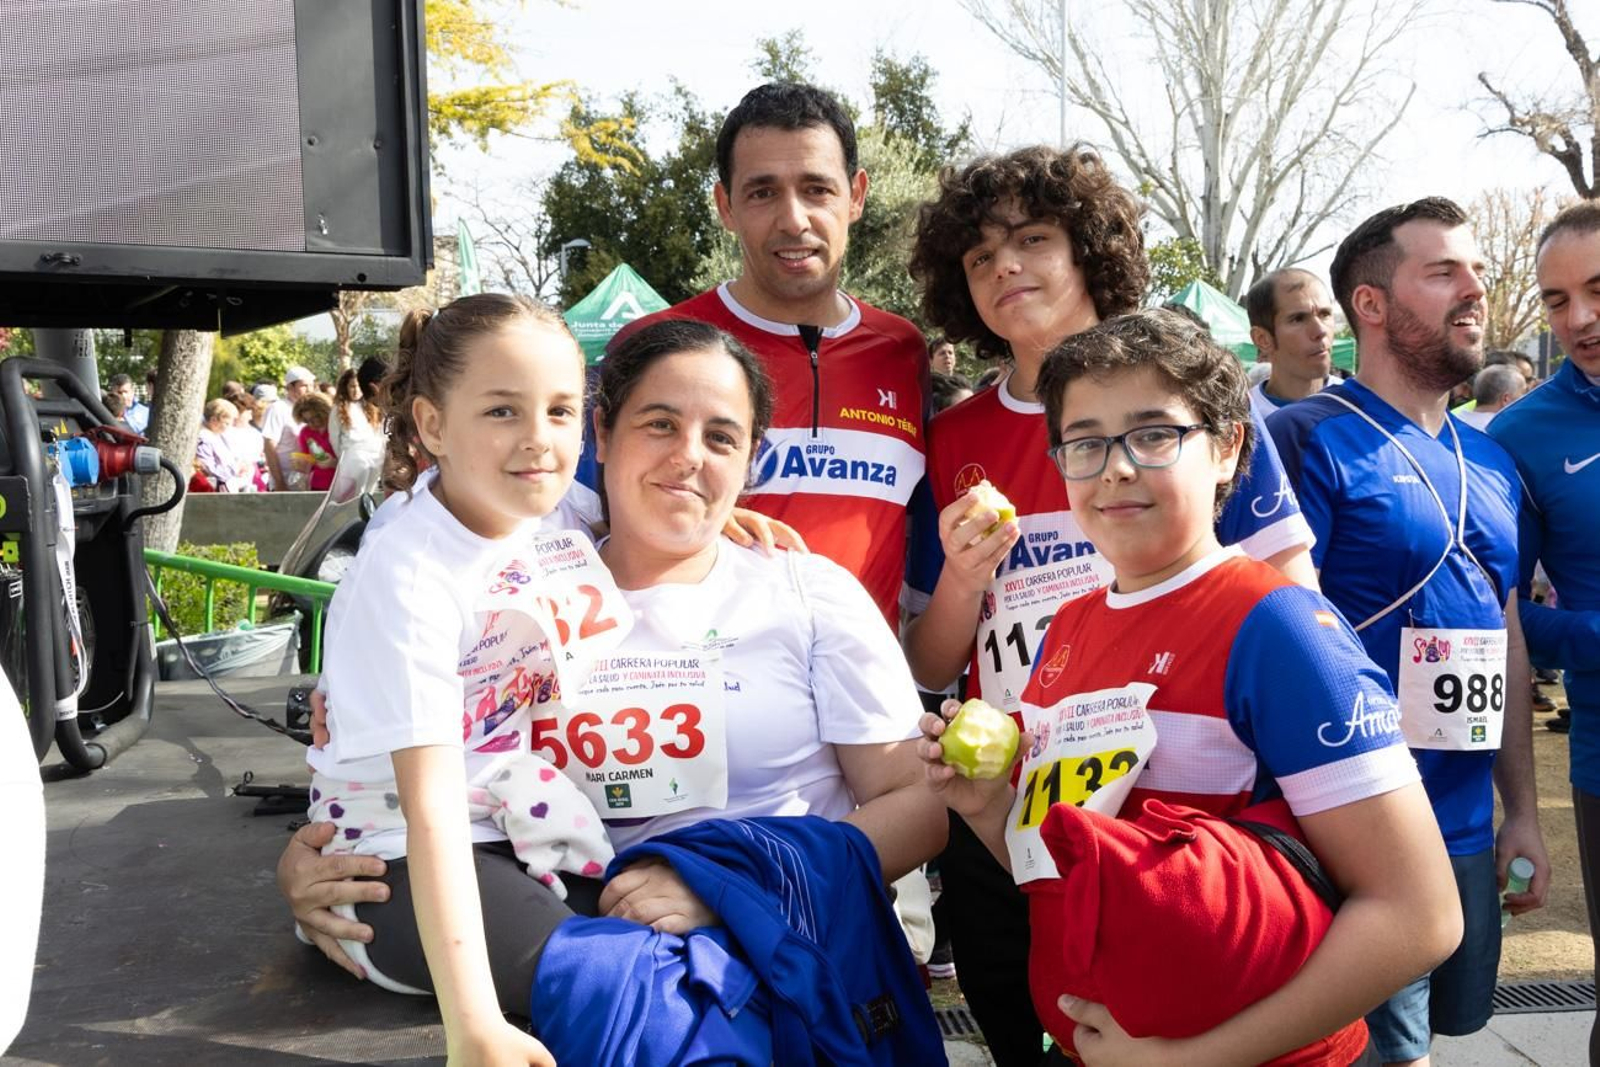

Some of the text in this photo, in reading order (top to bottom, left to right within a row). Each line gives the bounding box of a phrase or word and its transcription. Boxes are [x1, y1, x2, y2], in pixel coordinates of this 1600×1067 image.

[840, 407, 896, 427] ANTONIO
[806, 444, 835, 455] GRUPO
[780, 445, 897, 487] Avanza
[1028, 531, 1059, 544] GRUPO
[1009, 534, 1097, 571] Avan
[1025, 571, 1056, 587] CARRERA
[1057, 563, 1093, 581] POPULAR
[610, 657, 652, 670] CARRERA
[653, 658, 700, 670] POPULAR
[1433, 673, 1504, 713] 988
[531, 704, 706, 770] 5633
[608, 767, 654, 781] CARMEN
